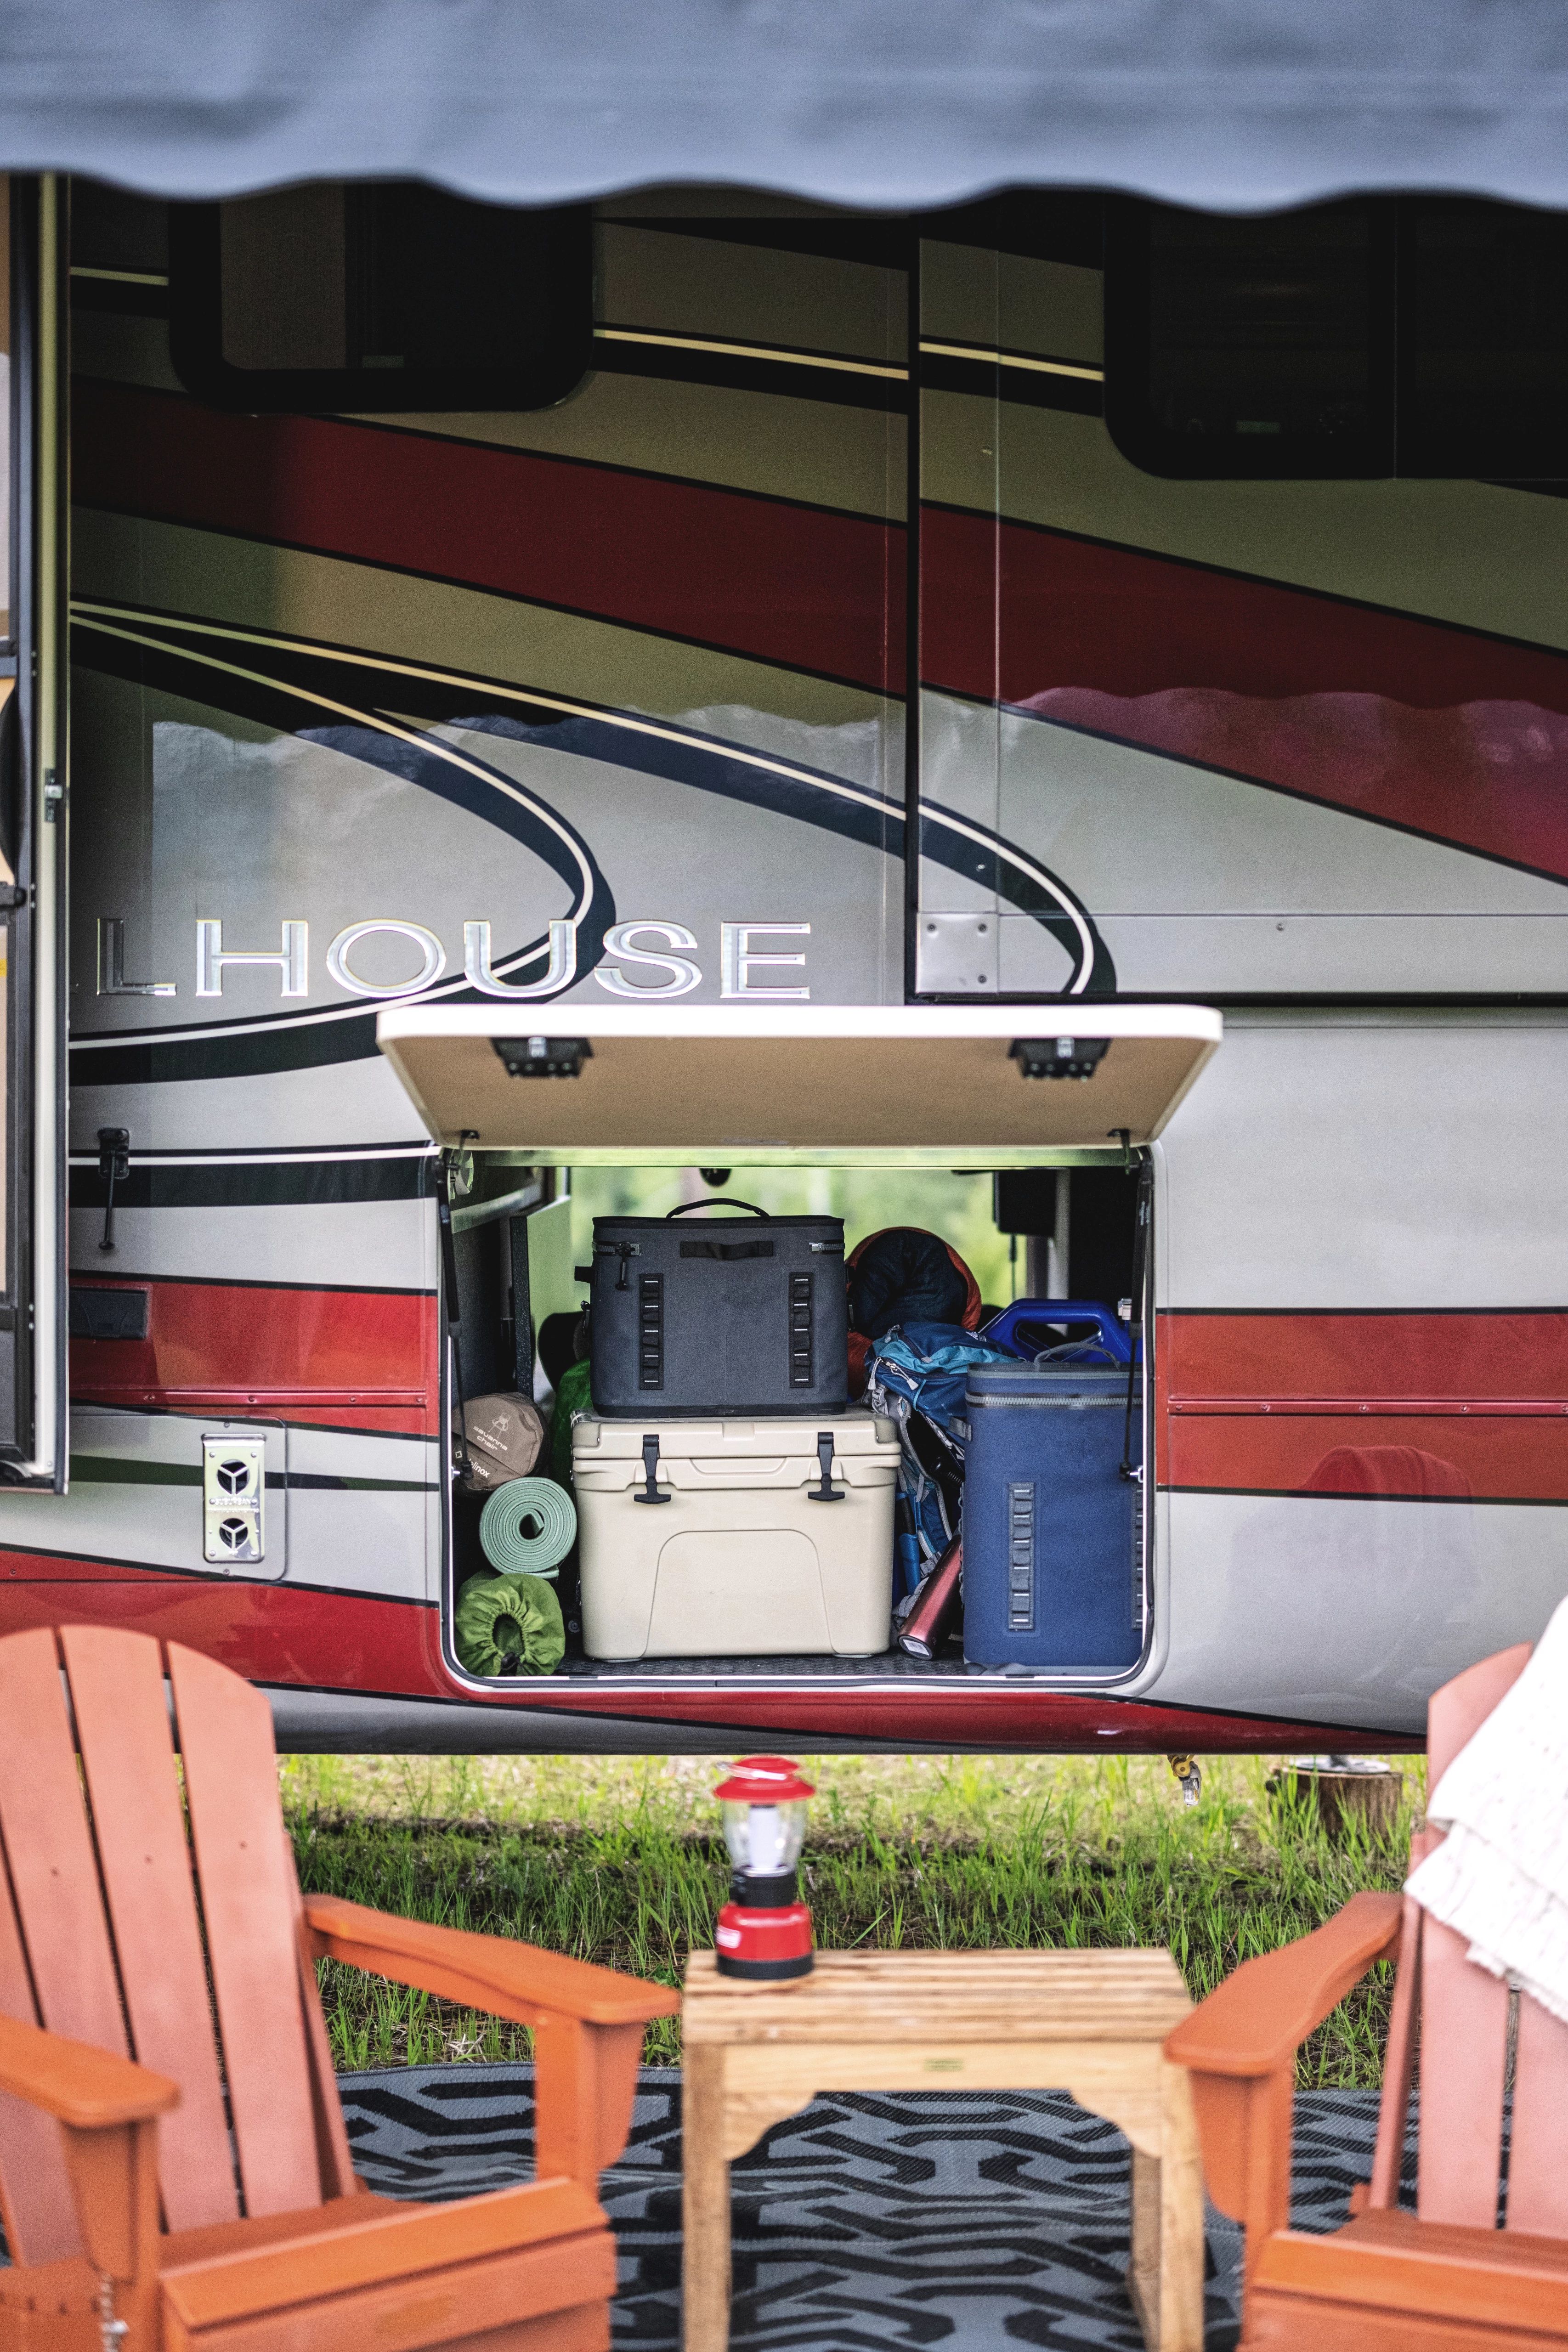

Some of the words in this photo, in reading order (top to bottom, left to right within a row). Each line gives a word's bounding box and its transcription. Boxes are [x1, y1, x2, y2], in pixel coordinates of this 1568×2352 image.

[69, 918, 176, 995] L
[195, 918, 811, 999] HOUSE
[473, 1426, 508, 1451] savanna
[477, 1435, 498, 1450] chair
[469, 1458, 490, 1478] elinox
